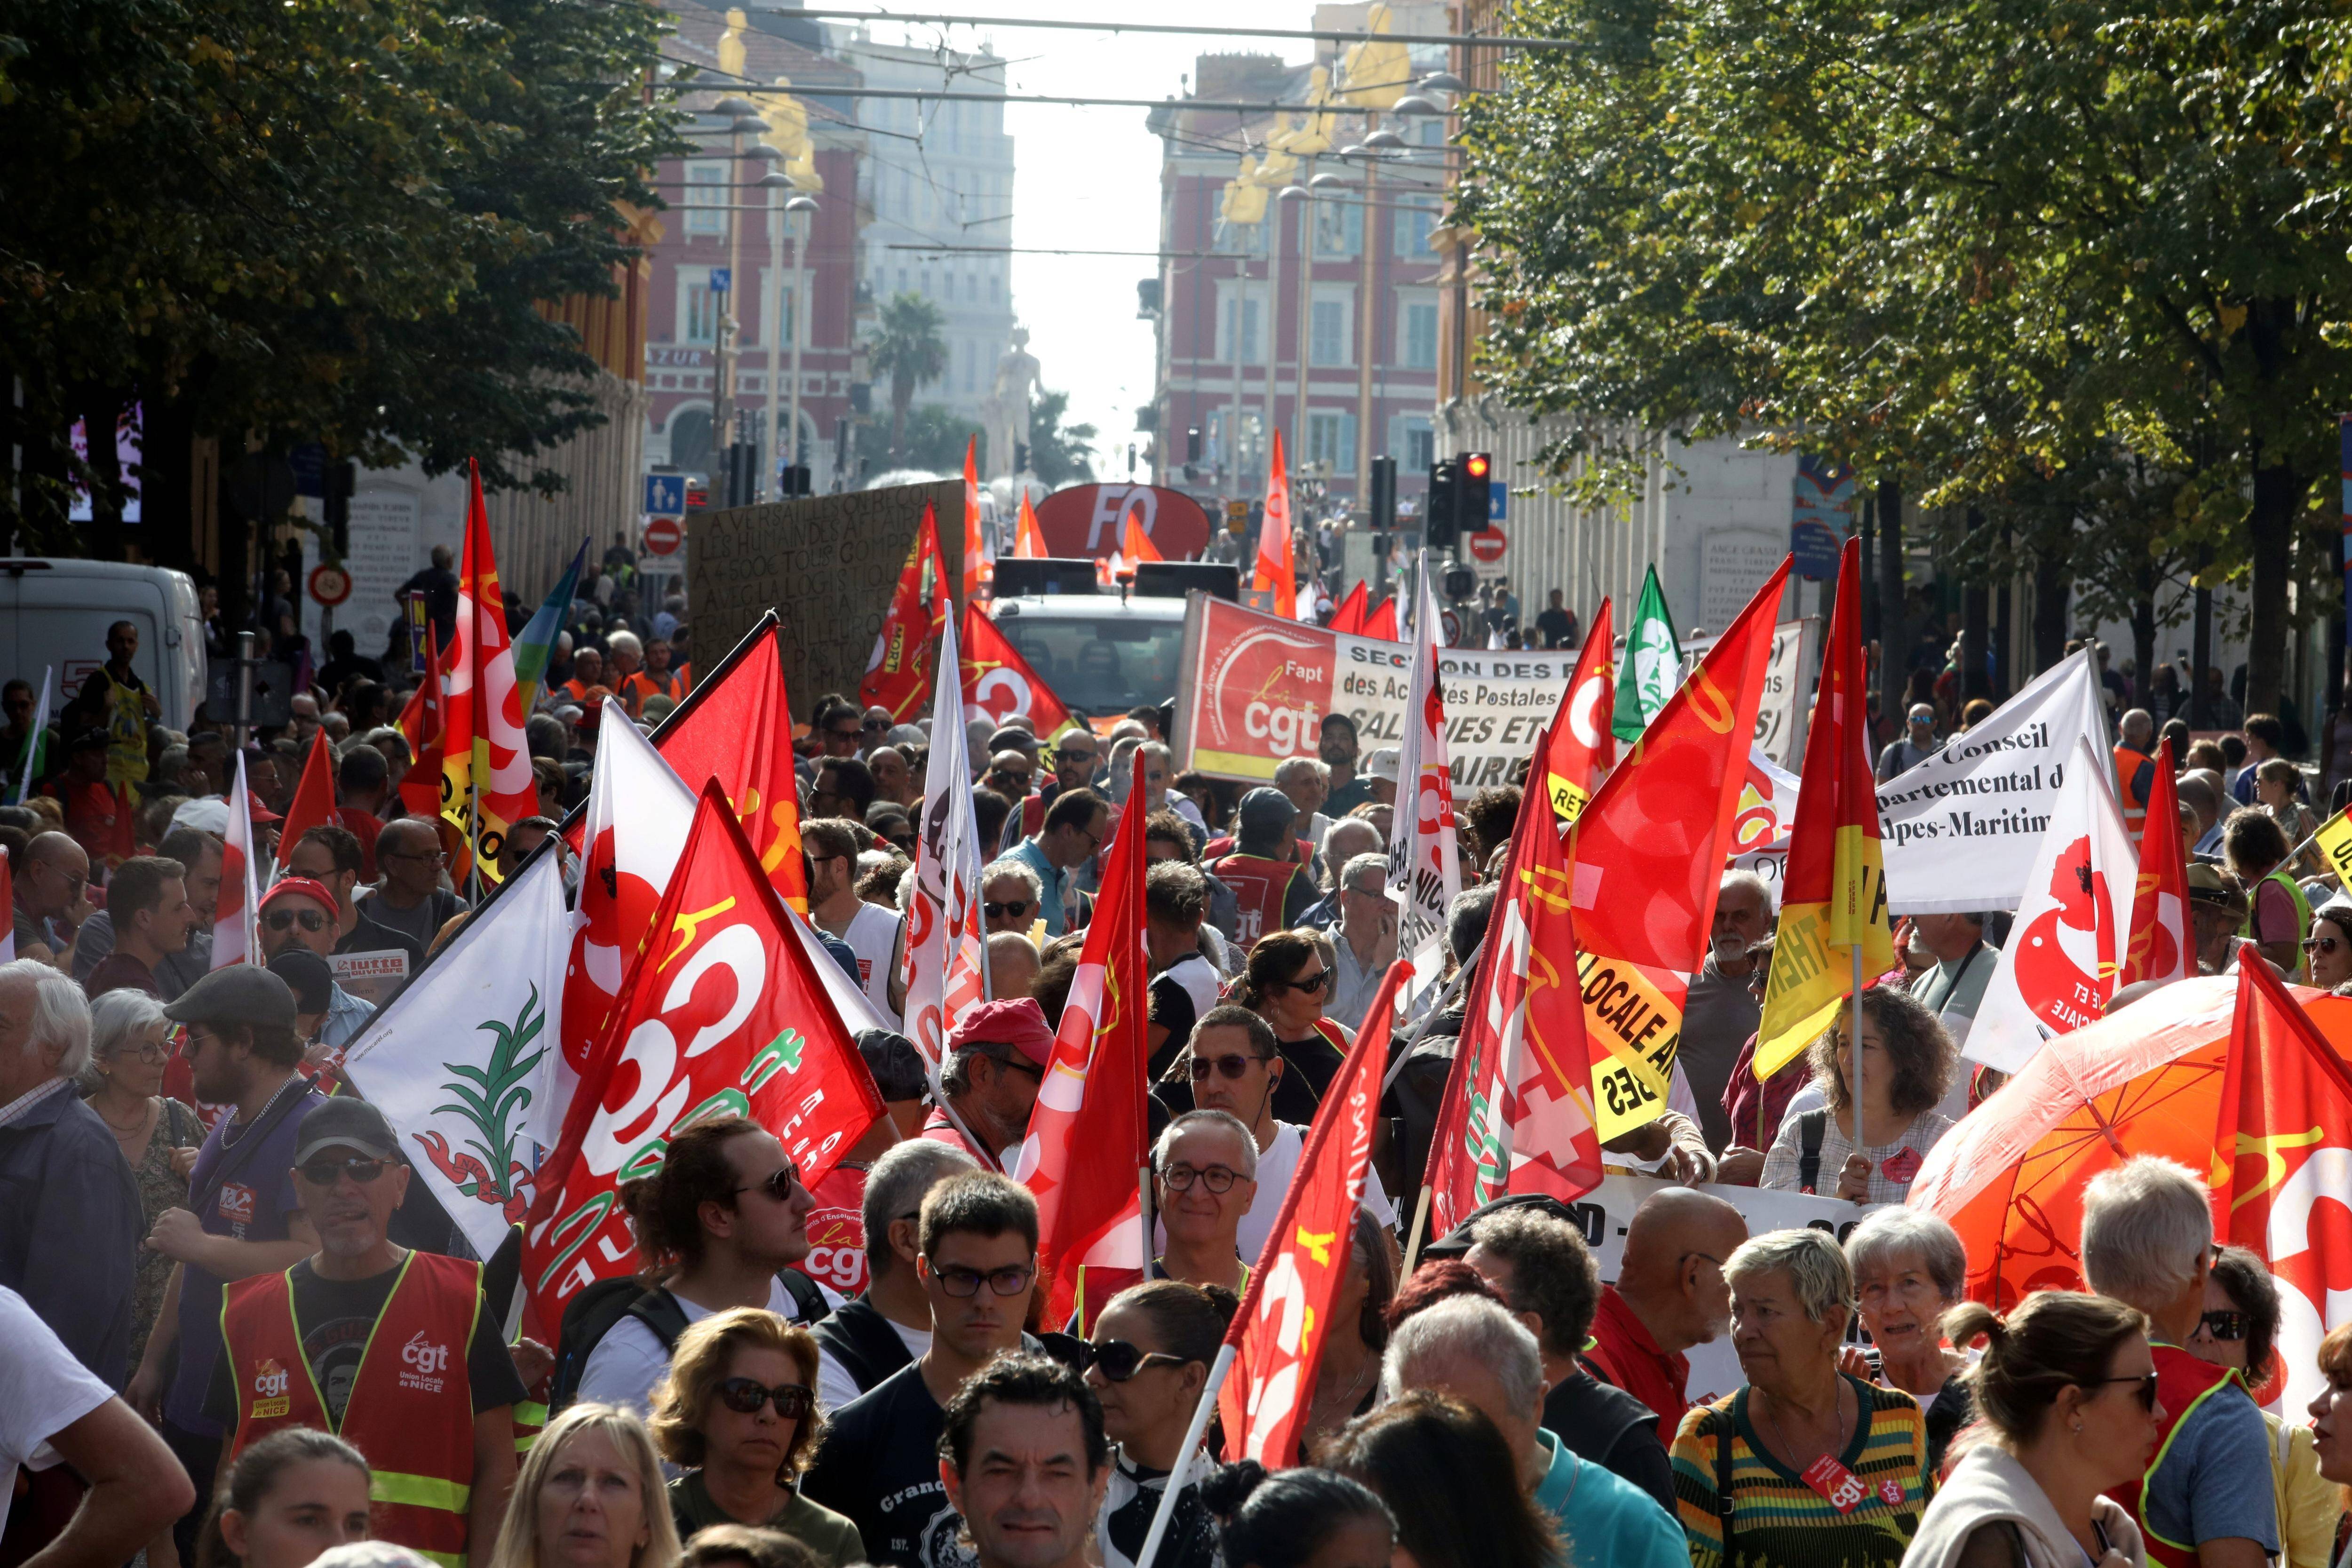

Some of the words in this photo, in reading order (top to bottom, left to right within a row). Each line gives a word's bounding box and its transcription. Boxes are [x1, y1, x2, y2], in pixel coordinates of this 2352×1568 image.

[1286, 660, 1323, 683] Fapt
[1493, 663, 1552, 679] DES
[1344, 671, 1377, 697] des
[1475, 685, 1557, 707] Postales
[1244, 700, 1319, 756] cgt
[1500, 716, 1548, 744] ET
[1942, 721, 2049, 765] Conseil
[1877, 764, 2042, 814] partemental
[350, 958, 403, 971] lutte
[354, 1028, 393, 1063] www.macarel.org
[804, 1247, 865, 1287] cg
[405, 1329, 430, 1347] la
[401, 1344, 449, 1374] cgt
[254, 1368, 289, 1398] cgt
[399, 1371, 419, 1380] Union
[421, 1376, 444, 1385] Locale
[409, 1381, 442, 1393] NICE
[262, 1406, 286, 1417] NICE
[270, 1399, 286, 1407] Locale
[1815, 1463, 1837, 1483] organismes
[1831, 1474, 1865, 1508] cgt
[891, 1537, 909, 1552] EST.
